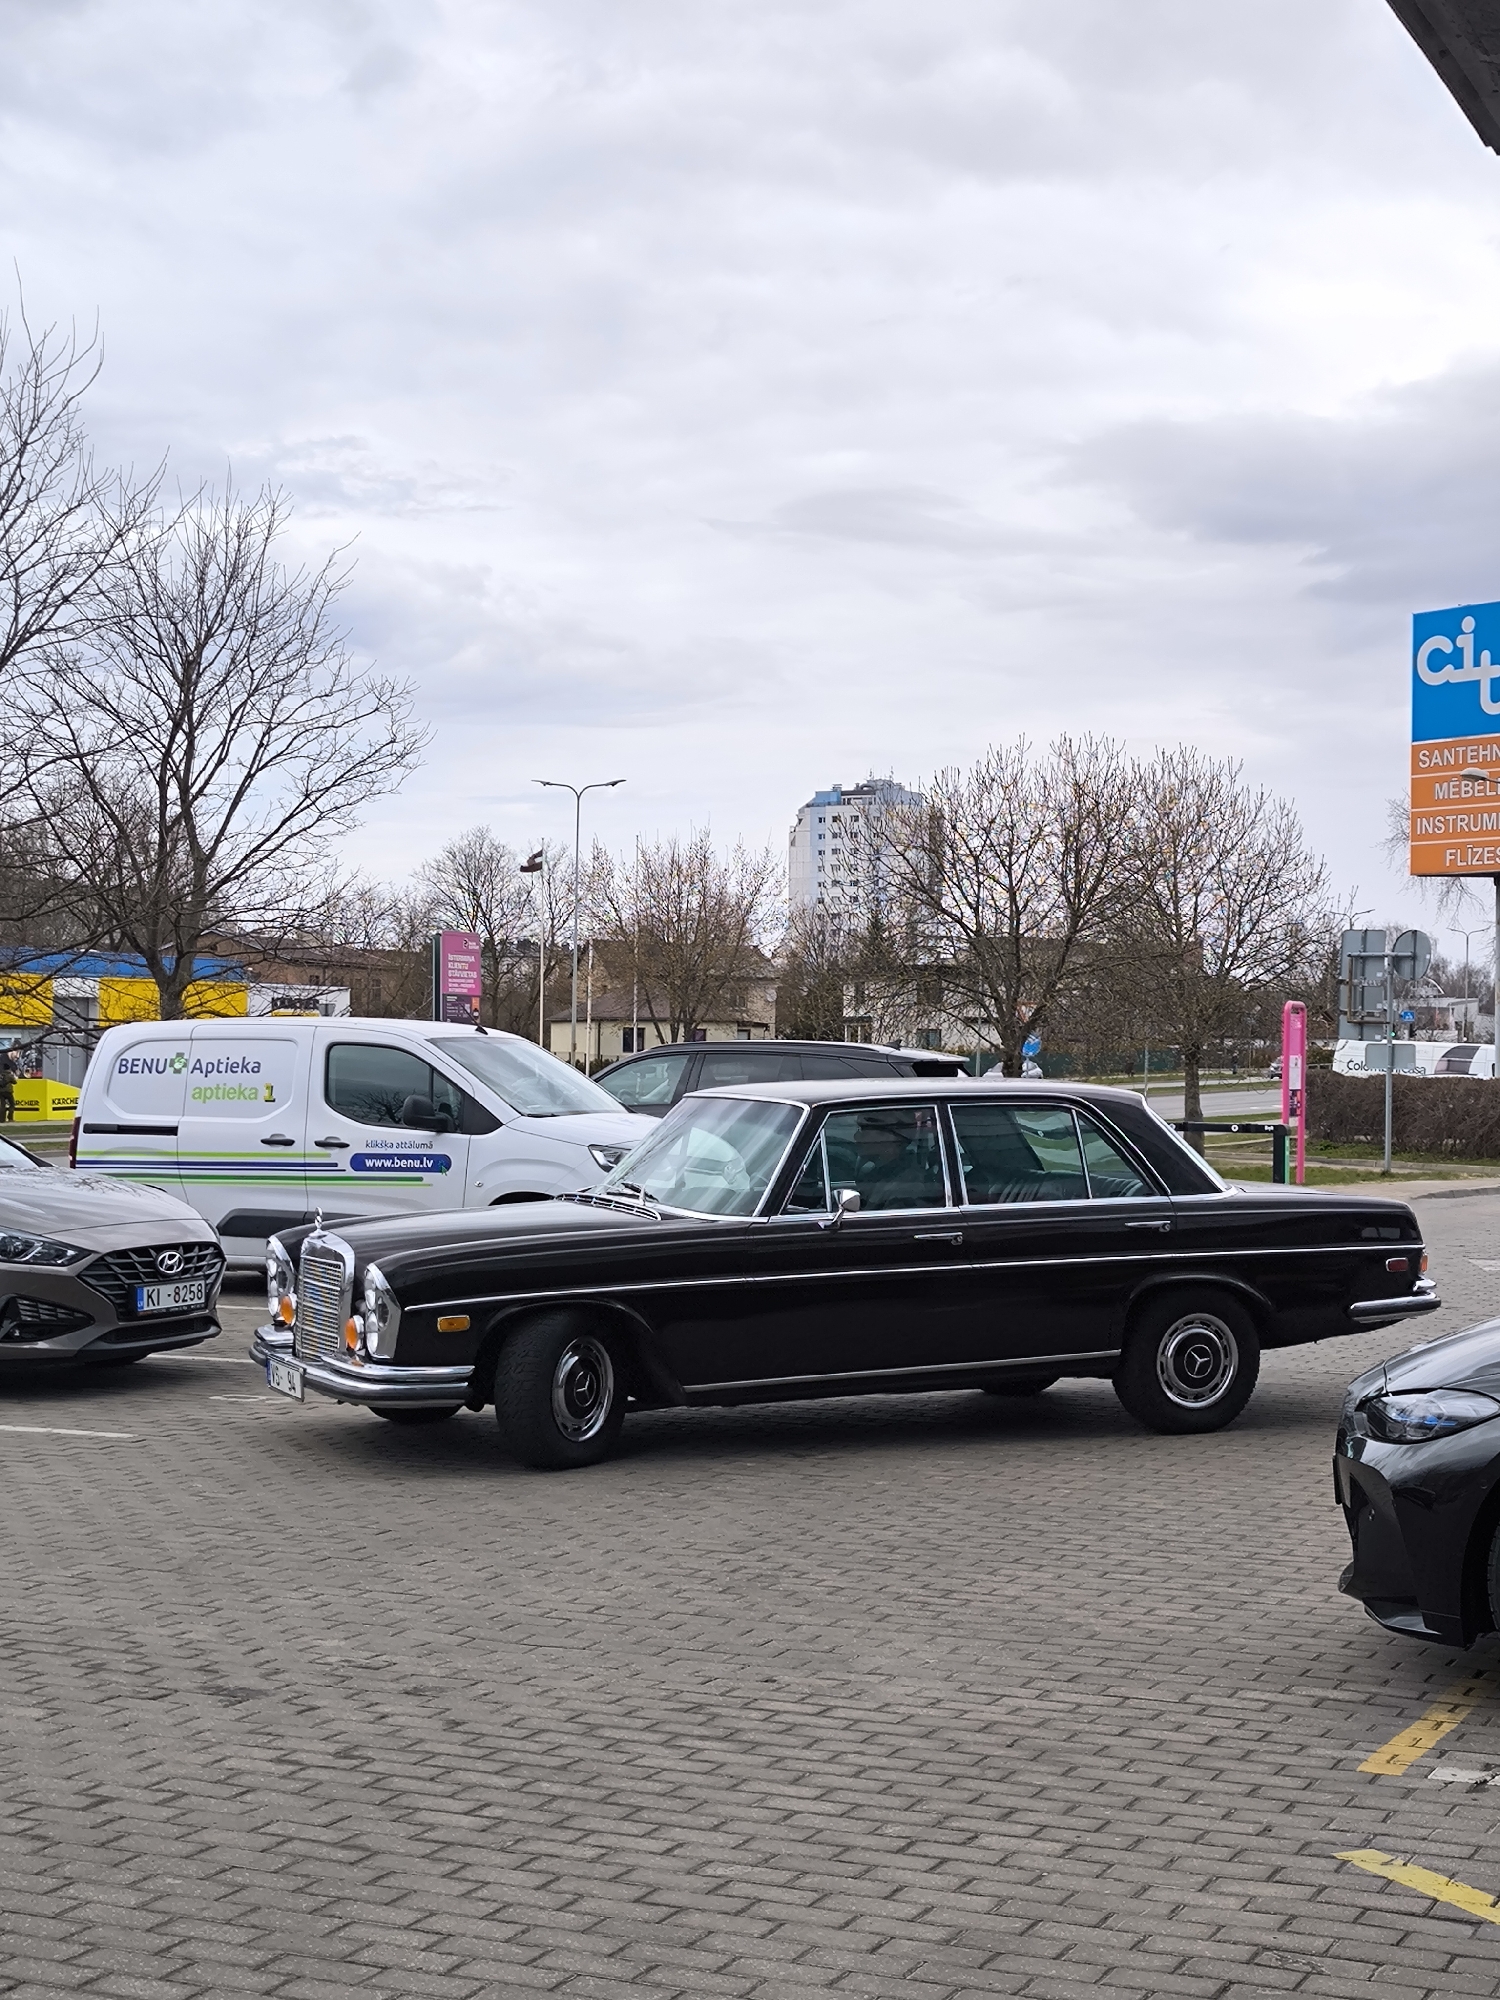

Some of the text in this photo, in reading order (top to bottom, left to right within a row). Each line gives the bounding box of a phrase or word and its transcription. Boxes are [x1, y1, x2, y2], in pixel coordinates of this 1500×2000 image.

[118, 1056, 262, 1078] BENU Aptieka
[191, 1082, 276, 1104] aptieka 1
[395, 1140, 434, 1150] attālumā
[365, 1156, 434, 1168] www.benu.lv
